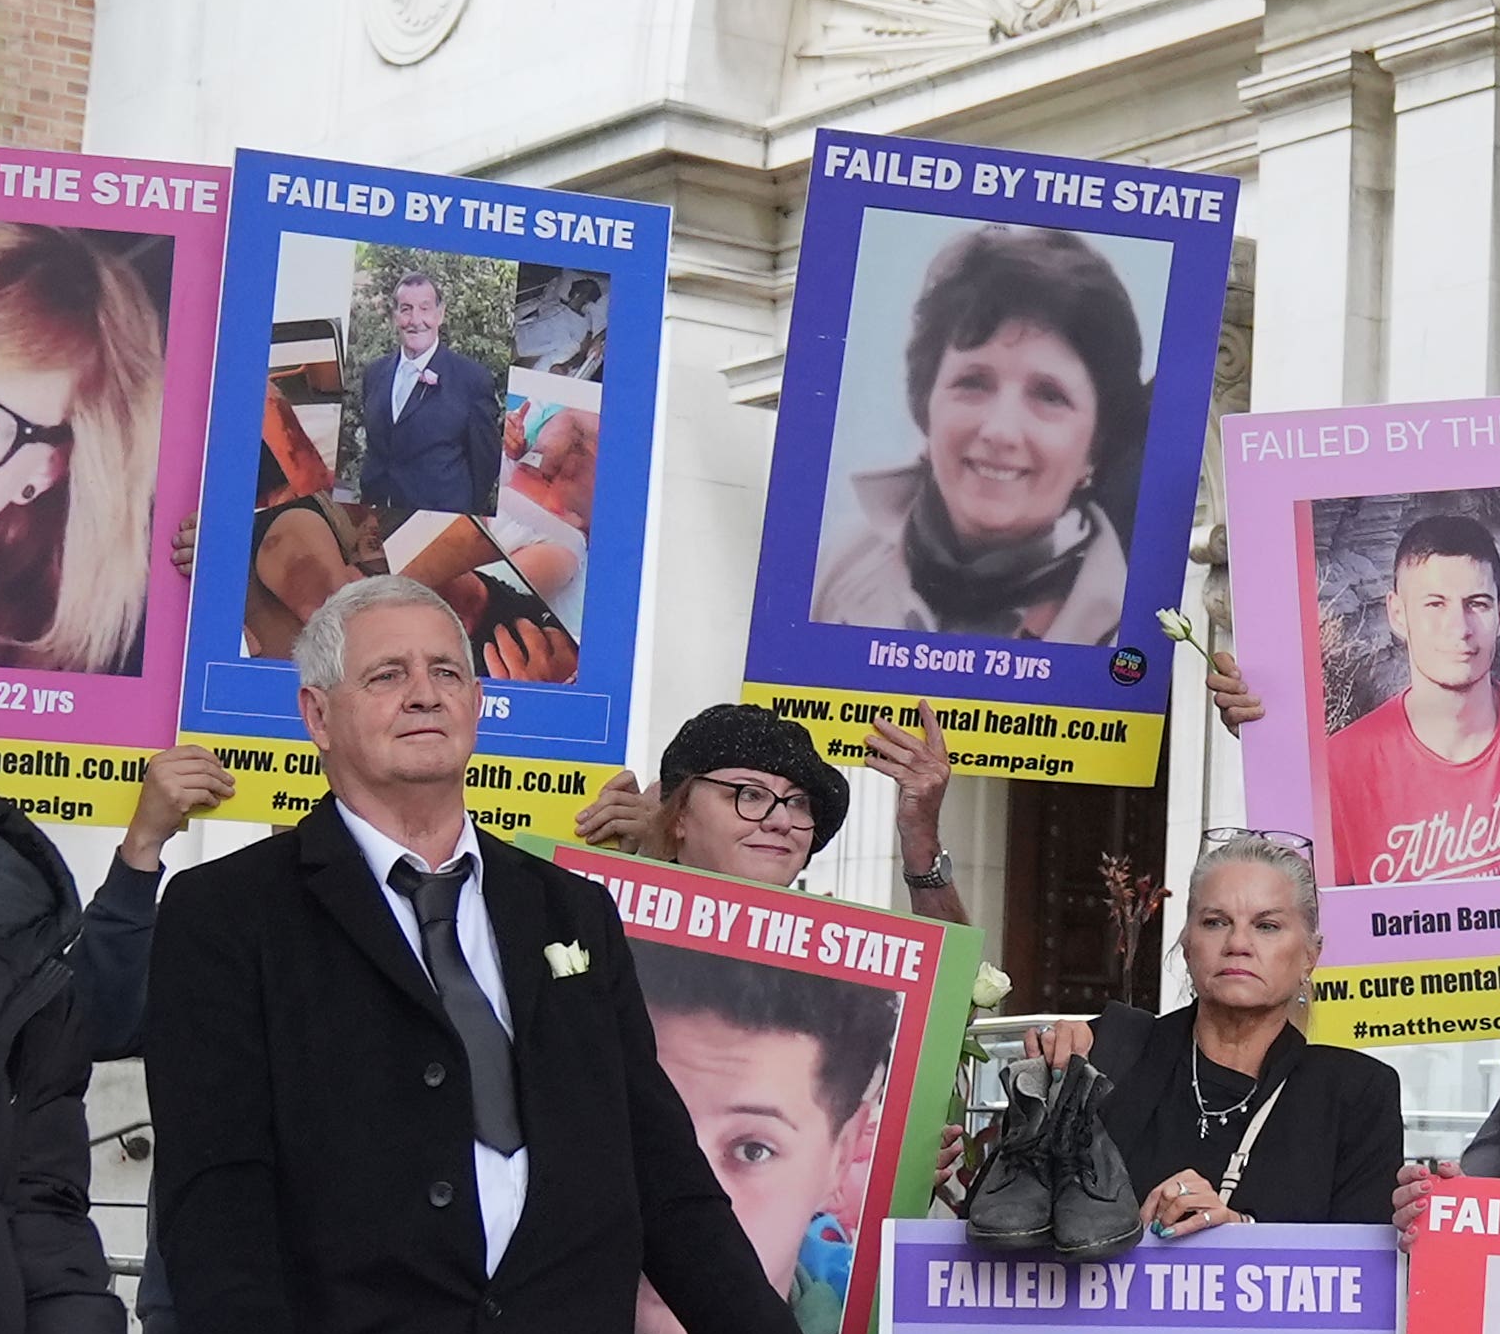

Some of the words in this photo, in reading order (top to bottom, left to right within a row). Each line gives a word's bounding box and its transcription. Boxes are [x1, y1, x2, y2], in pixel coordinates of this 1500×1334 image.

[868, 640, 910, 668] Iris
[913, 643, 976, 673] Scott
[983, 649, 1011, 676] 73
[1013, 656, 1051, 680] yrs
[31, 688, 74, 714] yrs
[1371, 909, 1451, 937] Darian
